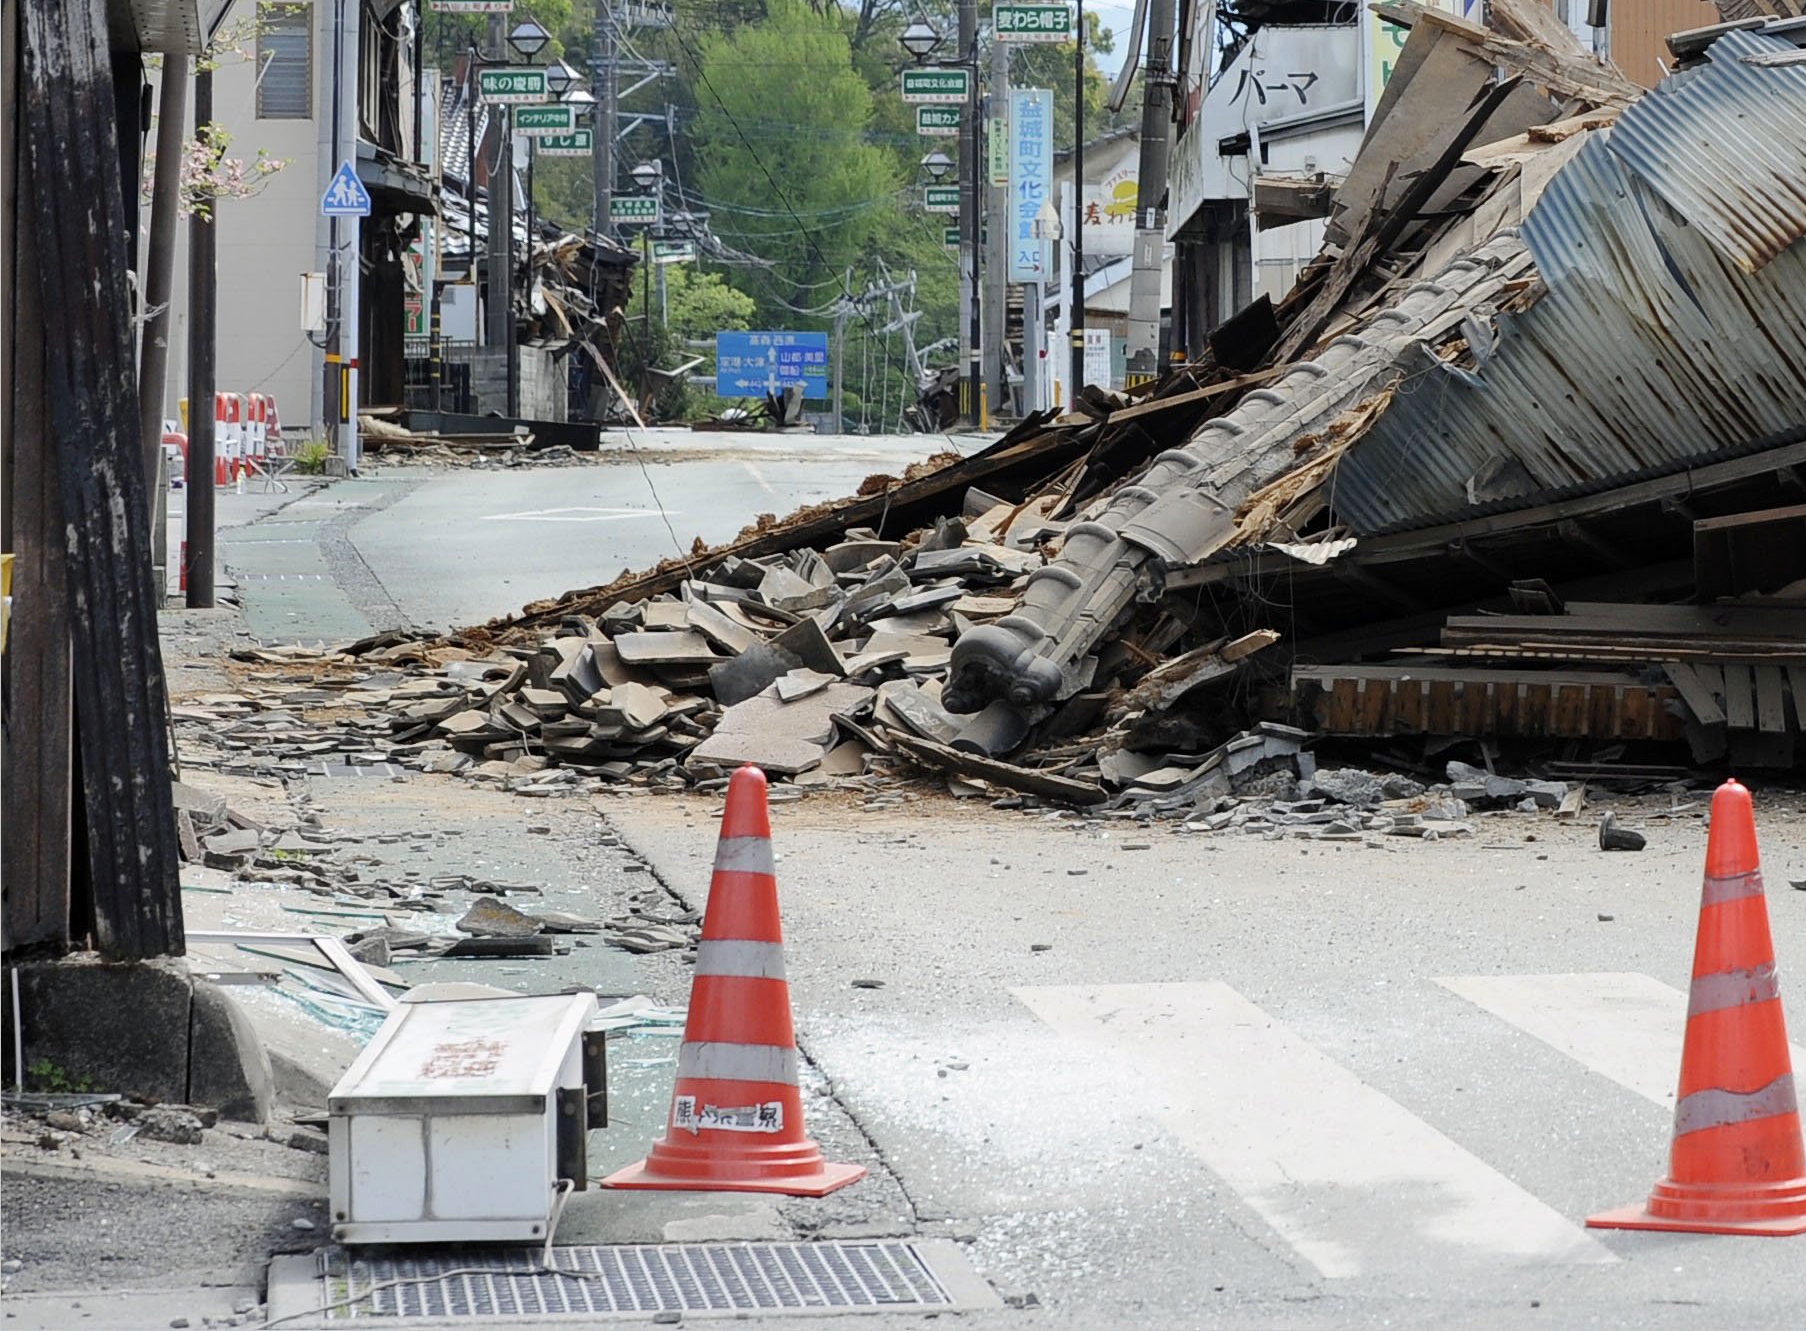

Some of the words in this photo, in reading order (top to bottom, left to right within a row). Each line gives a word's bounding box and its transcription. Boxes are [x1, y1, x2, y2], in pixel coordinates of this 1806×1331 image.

[997, 10, 1068, 30] 麦わら帽子
[1228, 69, 1319, 106] パーマ
